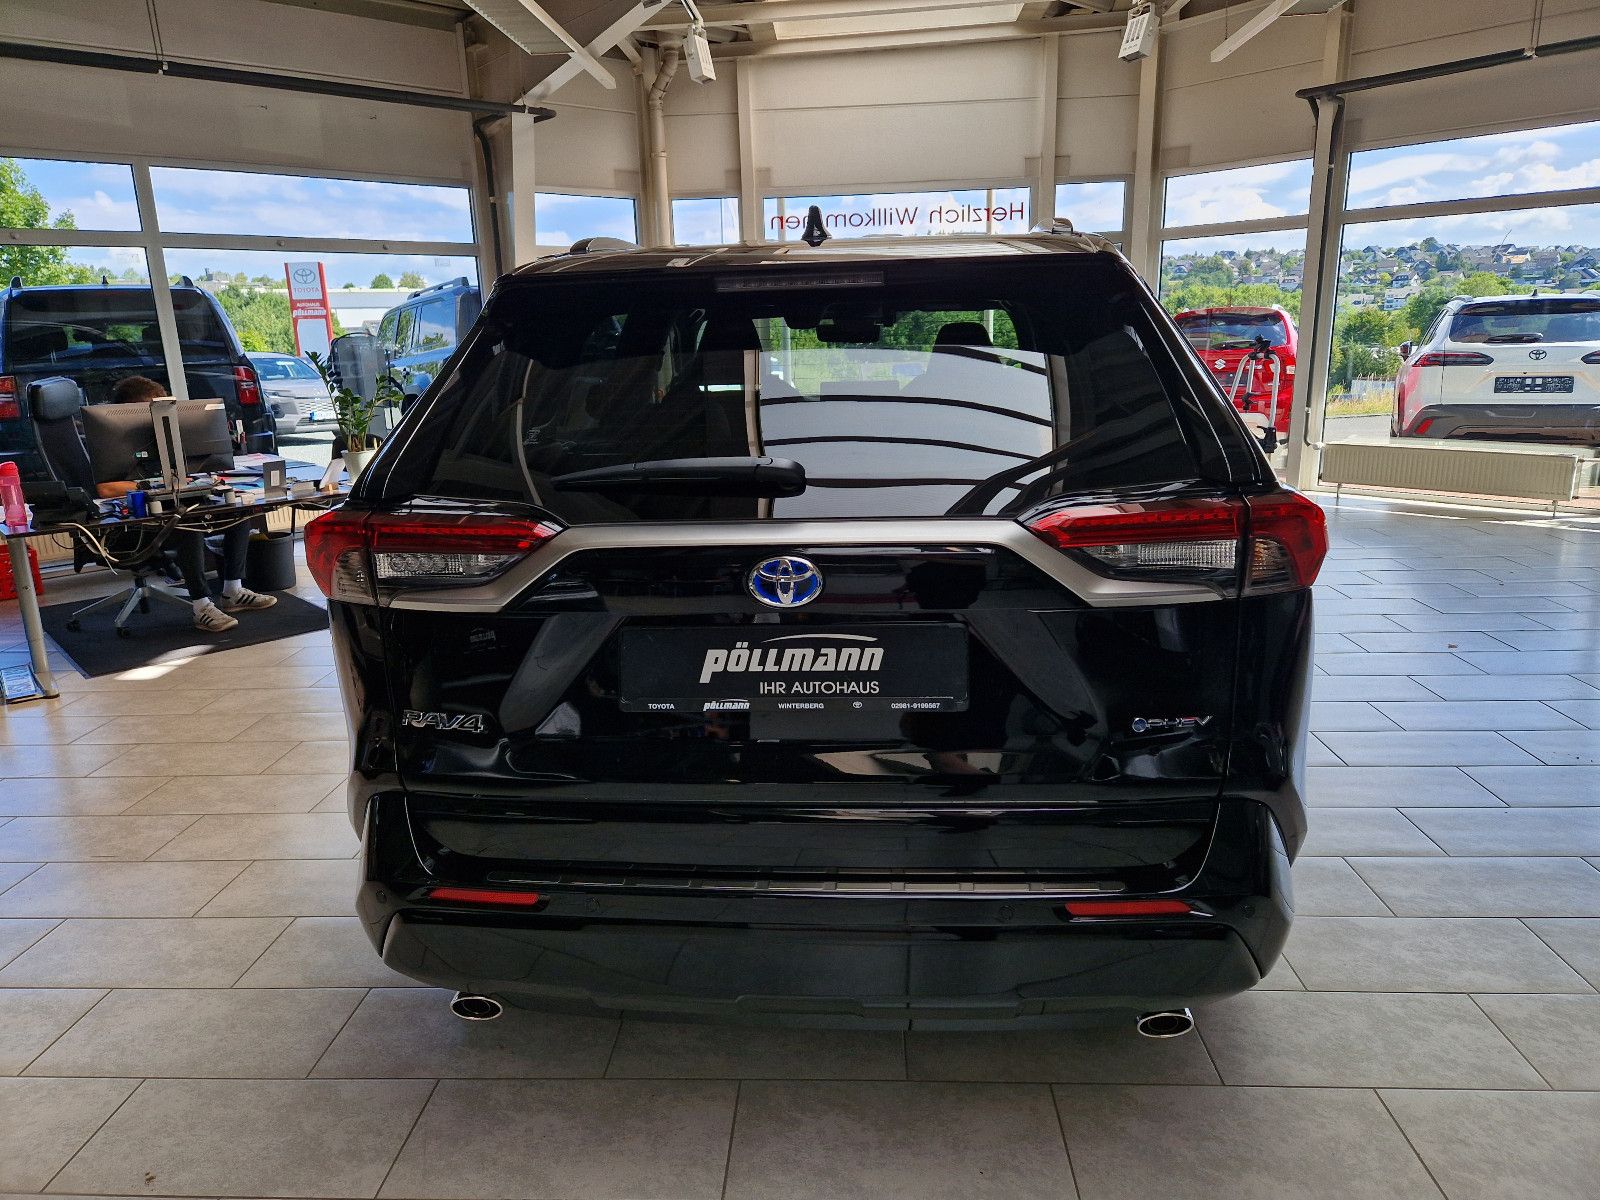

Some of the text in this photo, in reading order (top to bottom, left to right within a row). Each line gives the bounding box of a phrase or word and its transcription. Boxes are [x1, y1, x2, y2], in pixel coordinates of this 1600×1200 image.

[759, 680, 880, 695] IHR AUTOHAUS
[402, 709, 484, 733] RAV4
